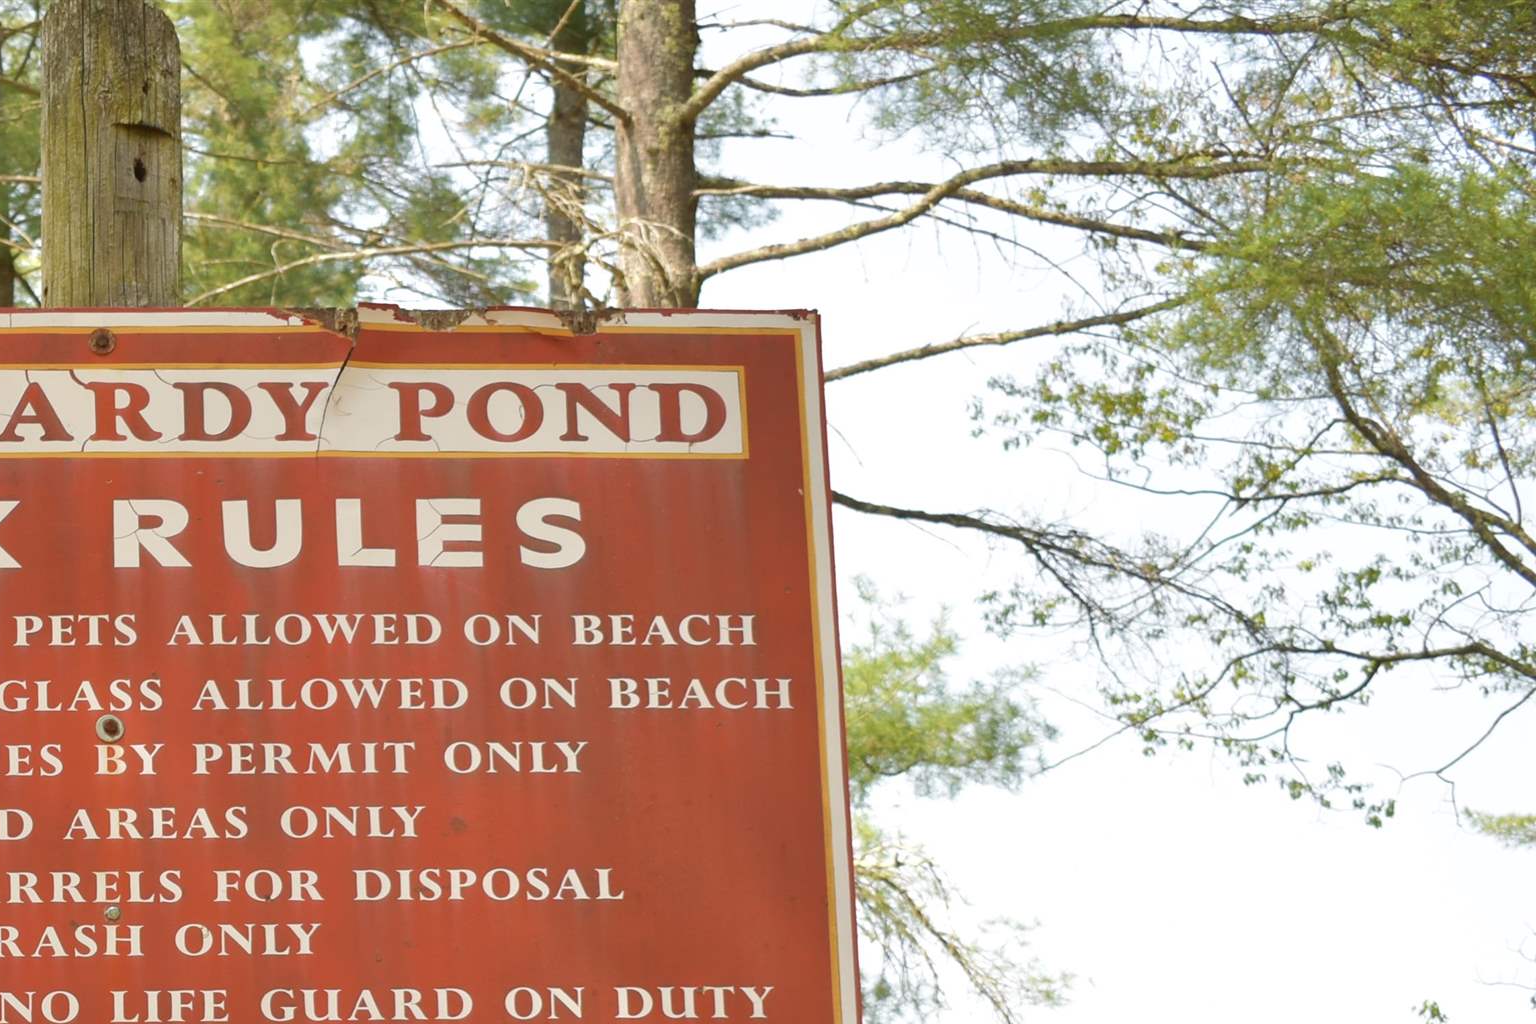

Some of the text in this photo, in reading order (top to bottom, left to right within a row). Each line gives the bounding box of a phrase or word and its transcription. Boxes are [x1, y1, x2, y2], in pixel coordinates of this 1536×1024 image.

[387, 381, 727, 443] POND
[113, 497, 586, 570] RULES
[14, 614, 138, 647] PETS
[167, 613, 442, 646] ALLOWED
[463, 613, 542, 646] ON
[571, 614, 757, 646] BEACH
[192, 678, 469, 711] ALLOWED
[499, 677, 578, 710] ON
[607, 677, 793, 710] BEACH
[95, 742, 164, 775] BY
[193, 741, 416, 775] PERMIT
[443, 741, 588, 774] ONLY
[64, 806, 249, 840] AREAS
[280, 805, 425, 839] ONLY
[215, 869, 324, 902] FOR
[353, 867, 625, 901] DISPOSAL
[174, 923, 321, 957] ONLY
[0, 990, 80, 1024] NO
[111, 989, 229, 1023] LIFE
[260, 987, 474, 1022] GUARD
[504, 986, 585, 1020] ON
[615, 985, 773, 1019] DUTY
